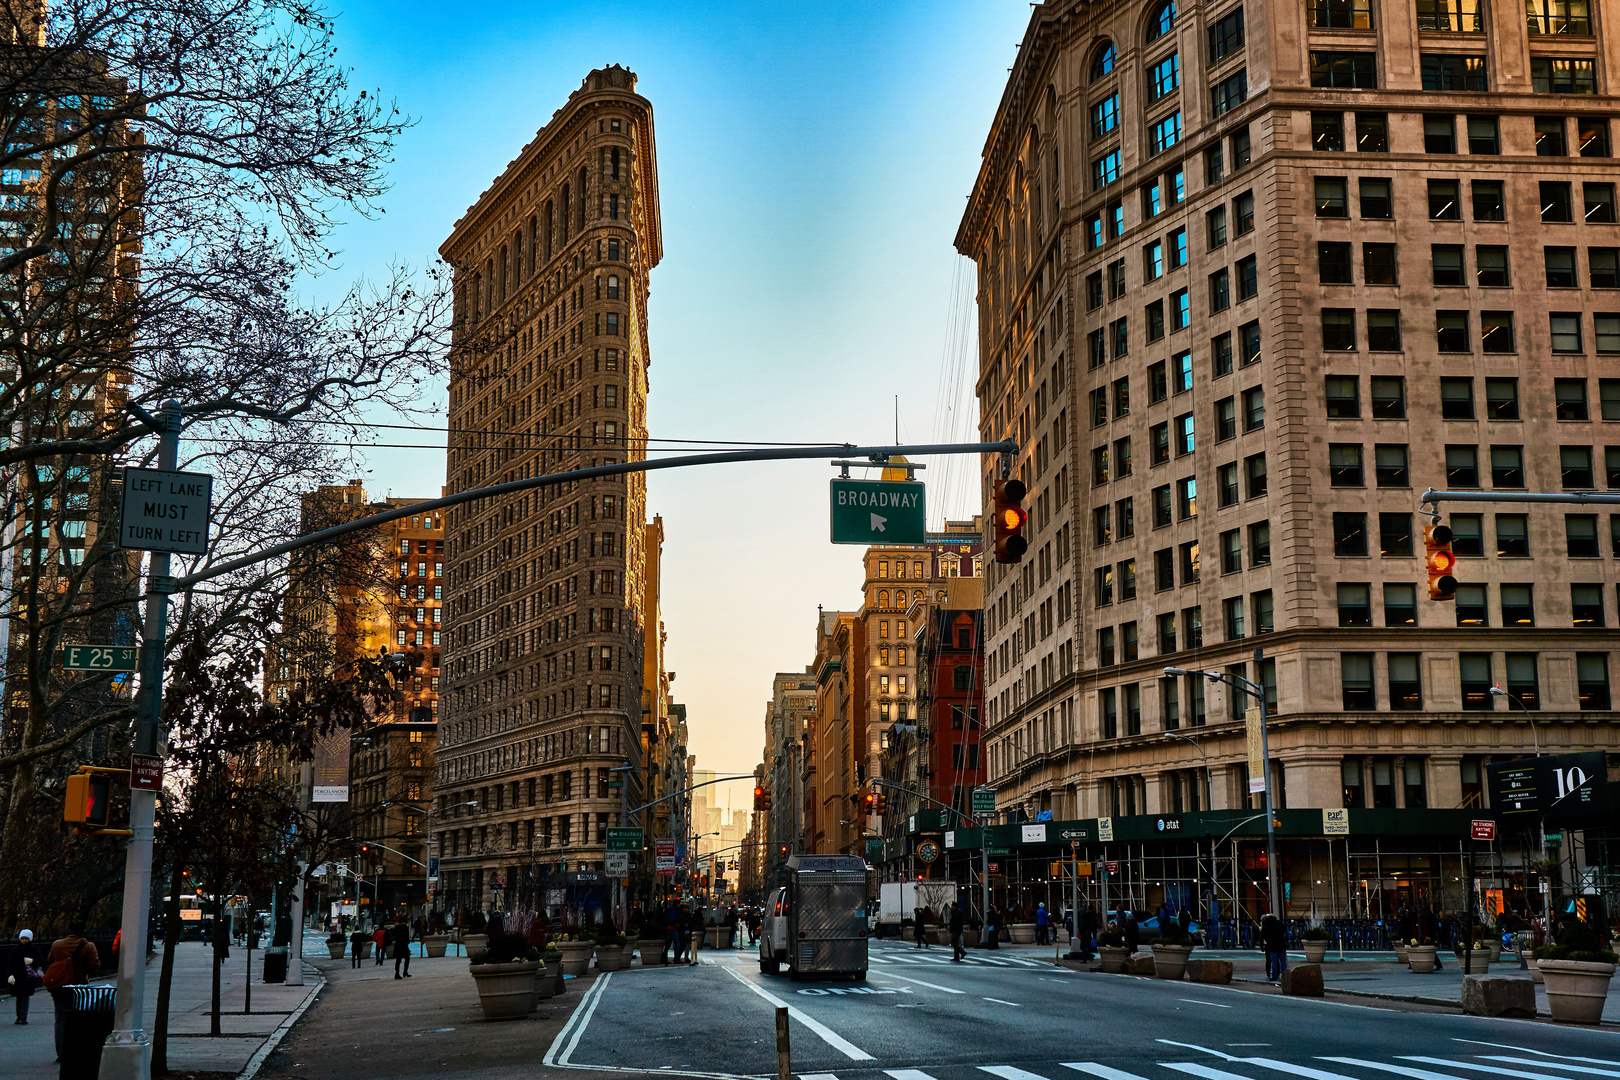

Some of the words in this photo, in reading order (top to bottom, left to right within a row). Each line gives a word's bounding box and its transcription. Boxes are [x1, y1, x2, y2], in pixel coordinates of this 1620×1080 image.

[131, 478, 163, 493] LEFT
[170, 482, 204, 497] LANE
[838, 490, 919, 508] BROADWAY
[143, 502, 189, 521] MUST
[127, 525, 163, 541] TURN
[169, 529, 201, 544] LEFT
[69, 648, 81, 667] E
[89, 649, 114, 668] 25
[122, 650, 134, 660] ST
[133, 757, 141, 766] NO
[141, 758, 163, 768] STANDING
[136, 767, 159, 777] ANYTIME
[1552, 766, 1587, 799] 10
[1165, 819, 1180, 830] at&t
[796, 986, 914, 996] ONLY
